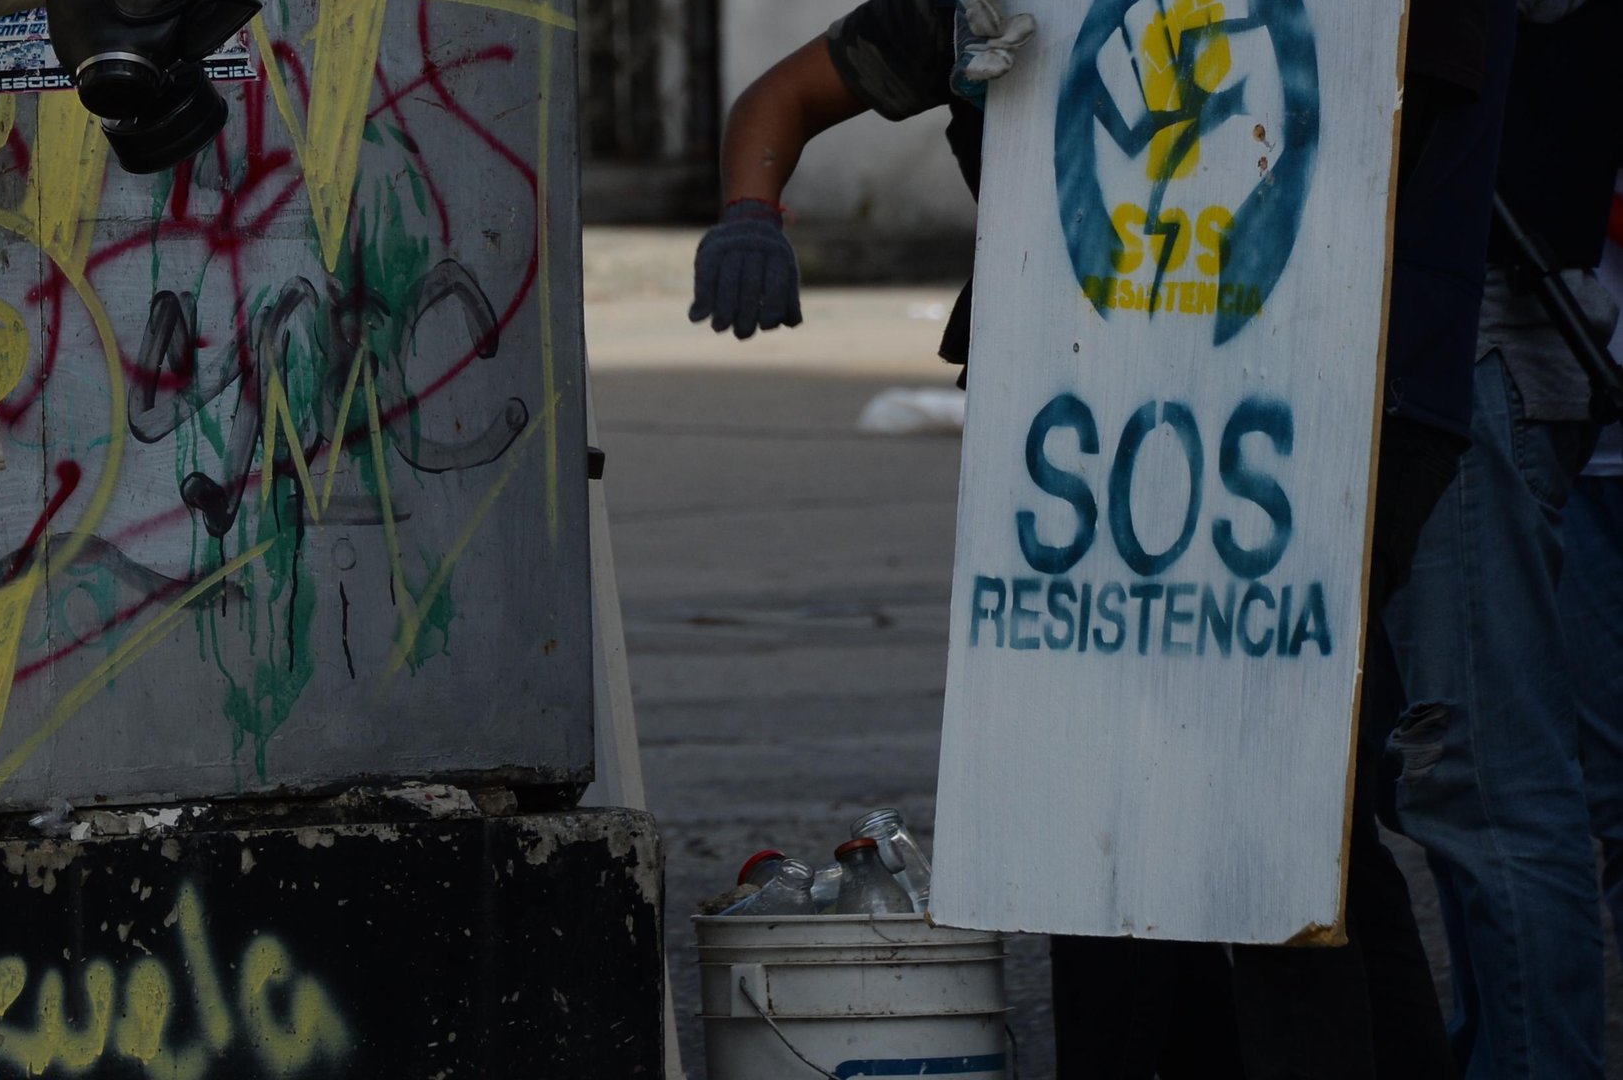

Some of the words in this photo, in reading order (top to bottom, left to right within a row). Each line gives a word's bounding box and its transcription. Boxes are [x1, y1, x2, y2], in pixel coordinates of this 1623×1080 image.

[1109, 202, 1236, 277] SOS
[1082, 275, 1263, 316] RESISTENCIA
[1016, 392, 1294, 578] SOS
[970, 575, 1333, 659] RESISTENCIA
